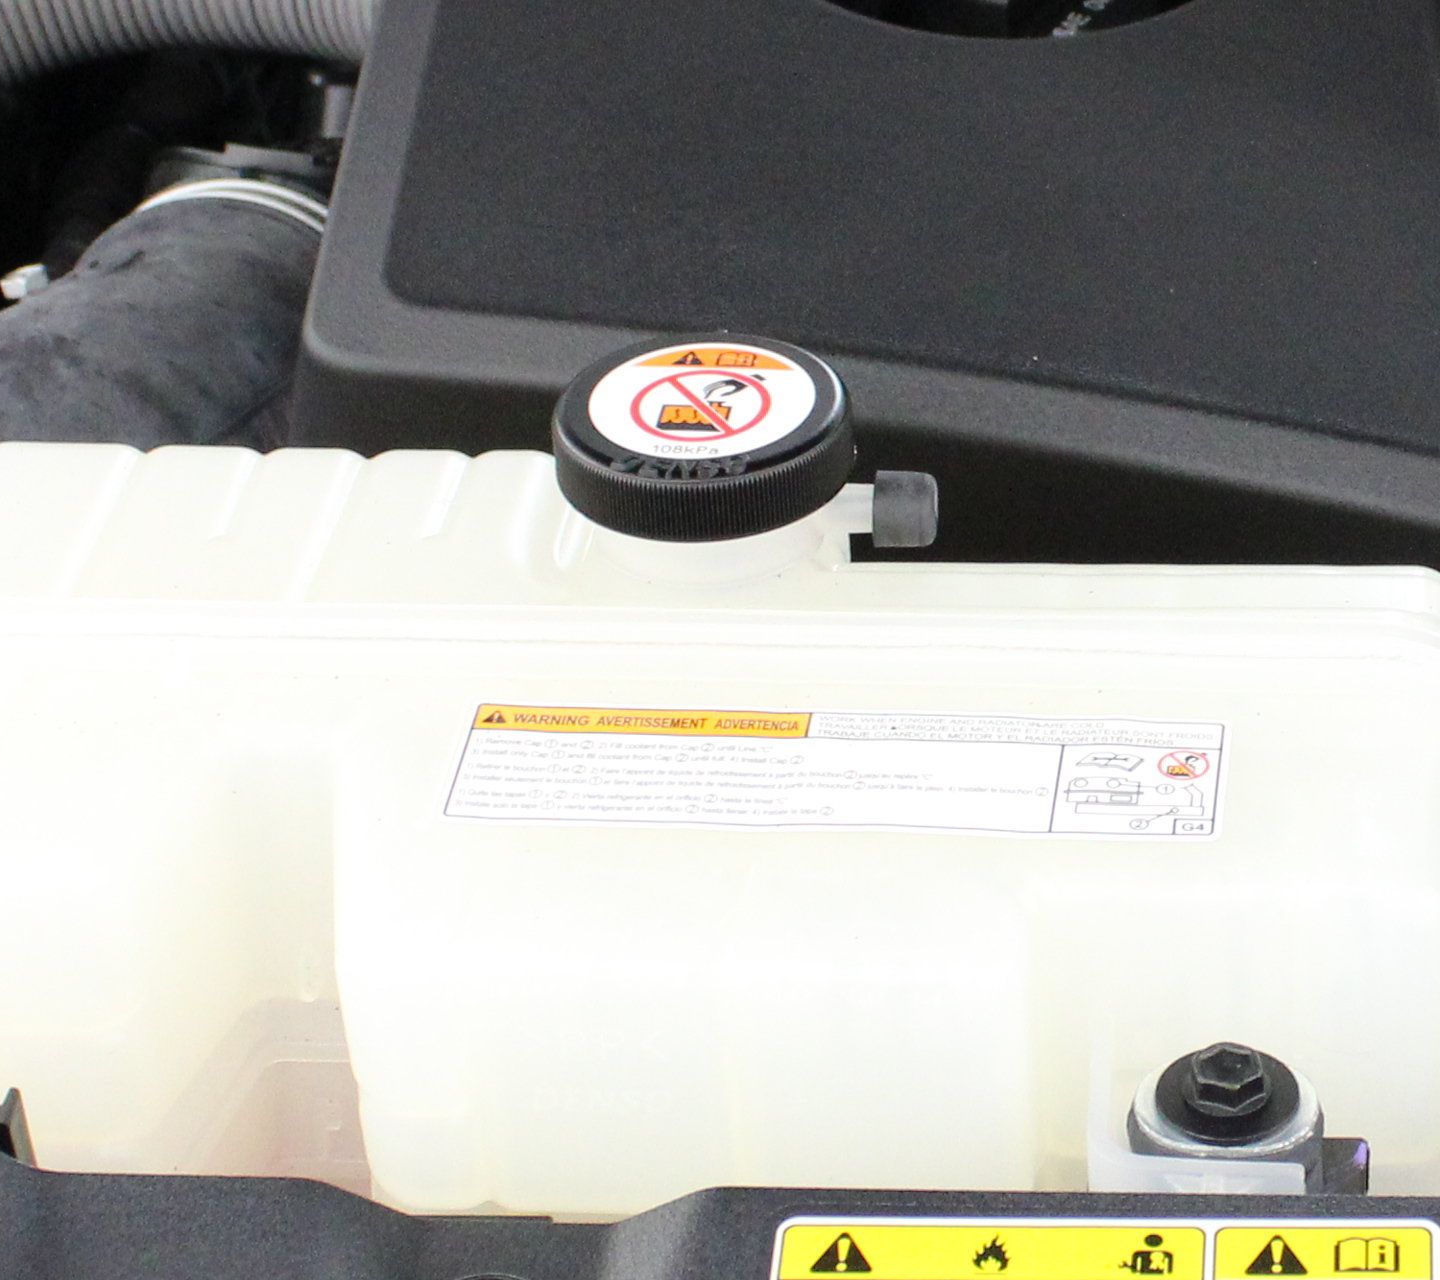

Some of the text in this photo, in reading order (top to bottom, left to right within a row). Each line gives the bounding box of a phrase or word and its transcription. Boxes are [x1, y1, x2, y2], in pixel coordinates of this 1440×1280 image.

[652, 443, 720, 456] 108kPa
[513, 712, 800, 732] WARNING AVERTISSEMENT ADVERTENCIA
[1181, 822, 1205, 832] G4
